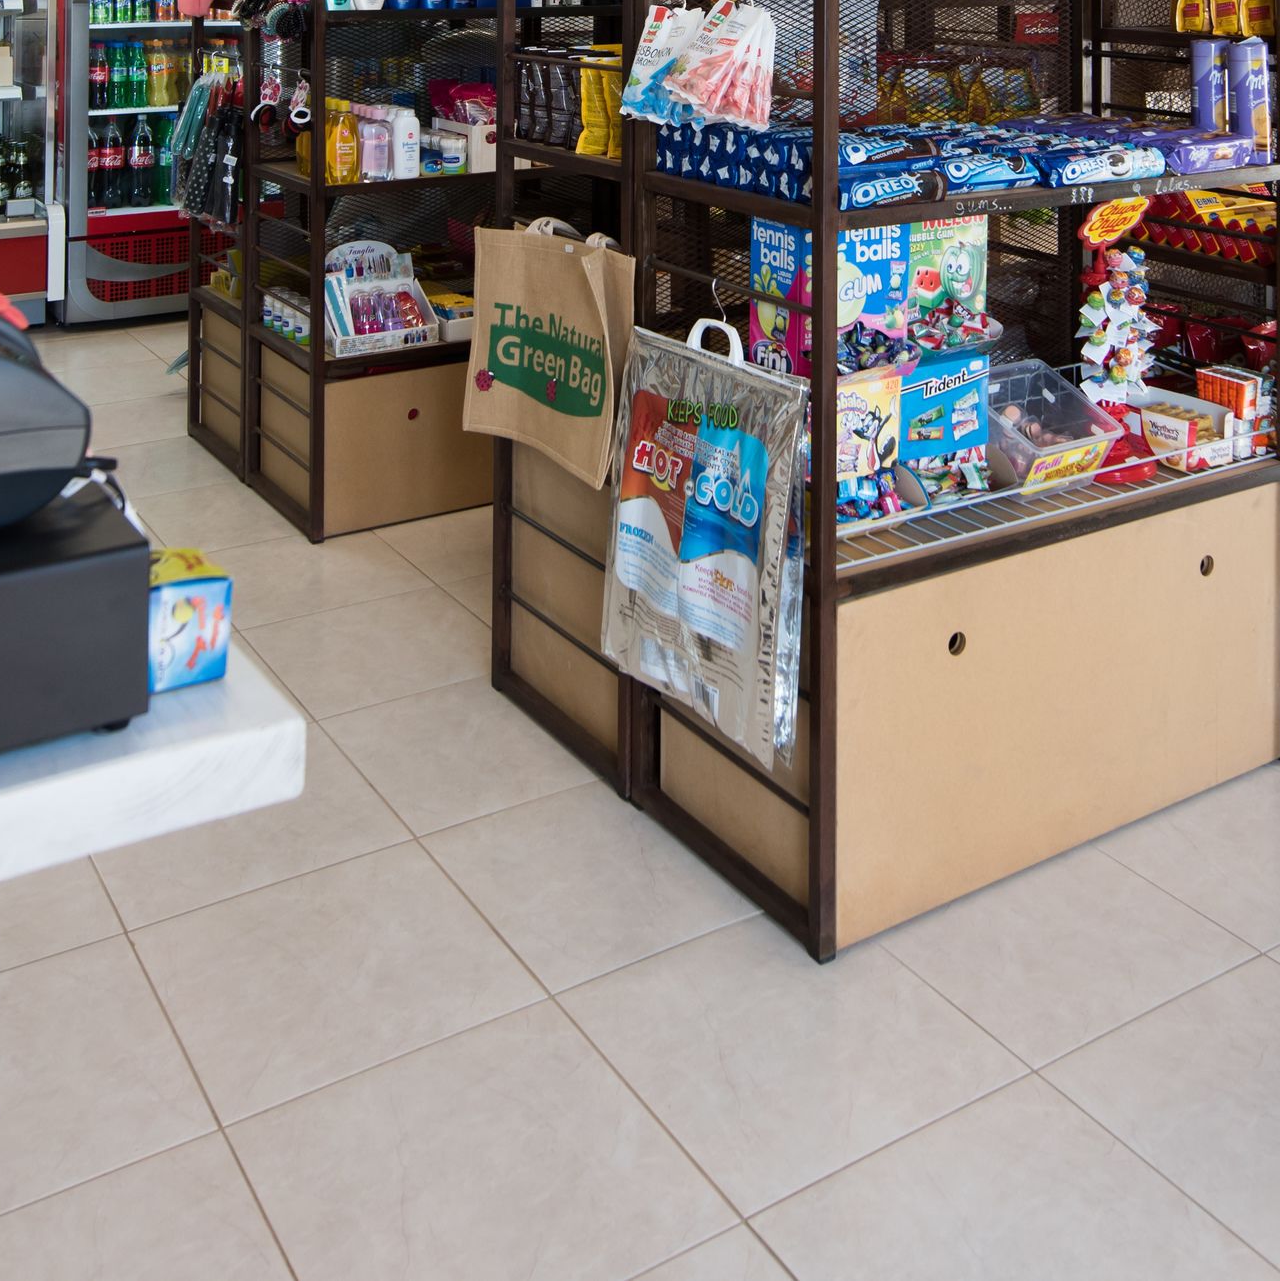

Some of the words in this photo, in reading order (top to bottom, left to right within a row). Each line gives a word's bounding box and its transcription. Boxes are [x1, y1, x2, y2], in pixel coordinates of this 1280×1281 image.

[1065, 159, 1104, 181] OREO
[856, 176, 913, 203] OREO
[1195, 196, 1220, 208] LEIBNIZ
[1099, 199, 1144, 219] Chupa
[753, 221, 796, 251] tennis
[936, 230, 955, 240] GUM
[1089, 213, 1135, 237] Chups
[760, 244, 795, 272] balls
[856, 238, 901, 263] balls
[839, 272, 882, 302] GUM
[494, 302, 544, 333] The
[549, 313, 605, 358] Natural
[756, 345, 788, 370] Fini
[496, 335, 566, 382] Green
[569, 355, 602, 407] Bag
[924, 368, 968, 397] Trident
[885, 378, 899, 390] 420
[667, 399, 702, 425] KEEPS
[707, 403, 739, 429] FOOD
[1149, 419, 1180, 436] Werther's
[1158, 430, 1179, 442] Original
[633, 440, 683, 489] HOT
[1034, 455, 1064, 475] Trolli
[695, 473, 759, 528] COLD
[619, 522, 654, 545] FROZEN
